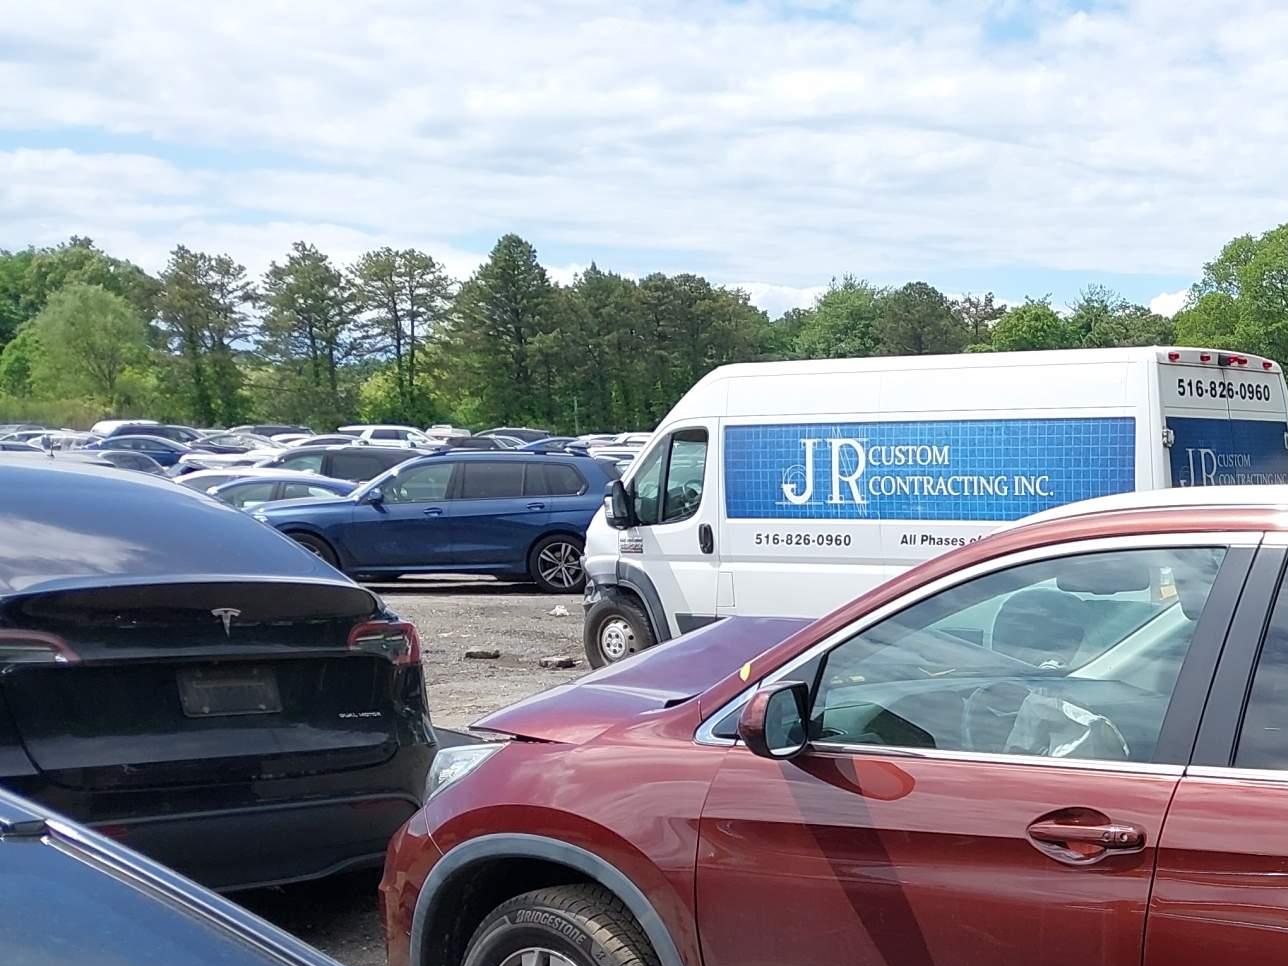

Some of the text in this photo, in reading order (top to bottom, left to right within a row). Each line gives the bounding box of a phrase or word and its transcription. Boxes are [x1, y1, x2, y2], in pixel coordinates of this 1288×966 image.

[1177, 378, 1271, 402] 516-826-0960
[868, 445, 950, 466] CUSTOM
[1217, 453, 1251, 468] CUSTOM
[868, 474, 1054, 497] CONTRACTING INC.
[754, 532, 852, 547] 516-826-0960
[900, 533, 917, 546] All
[920, 533, 966, 547] Phases
[515, 909, 588, 945] BRIDGESTONE
